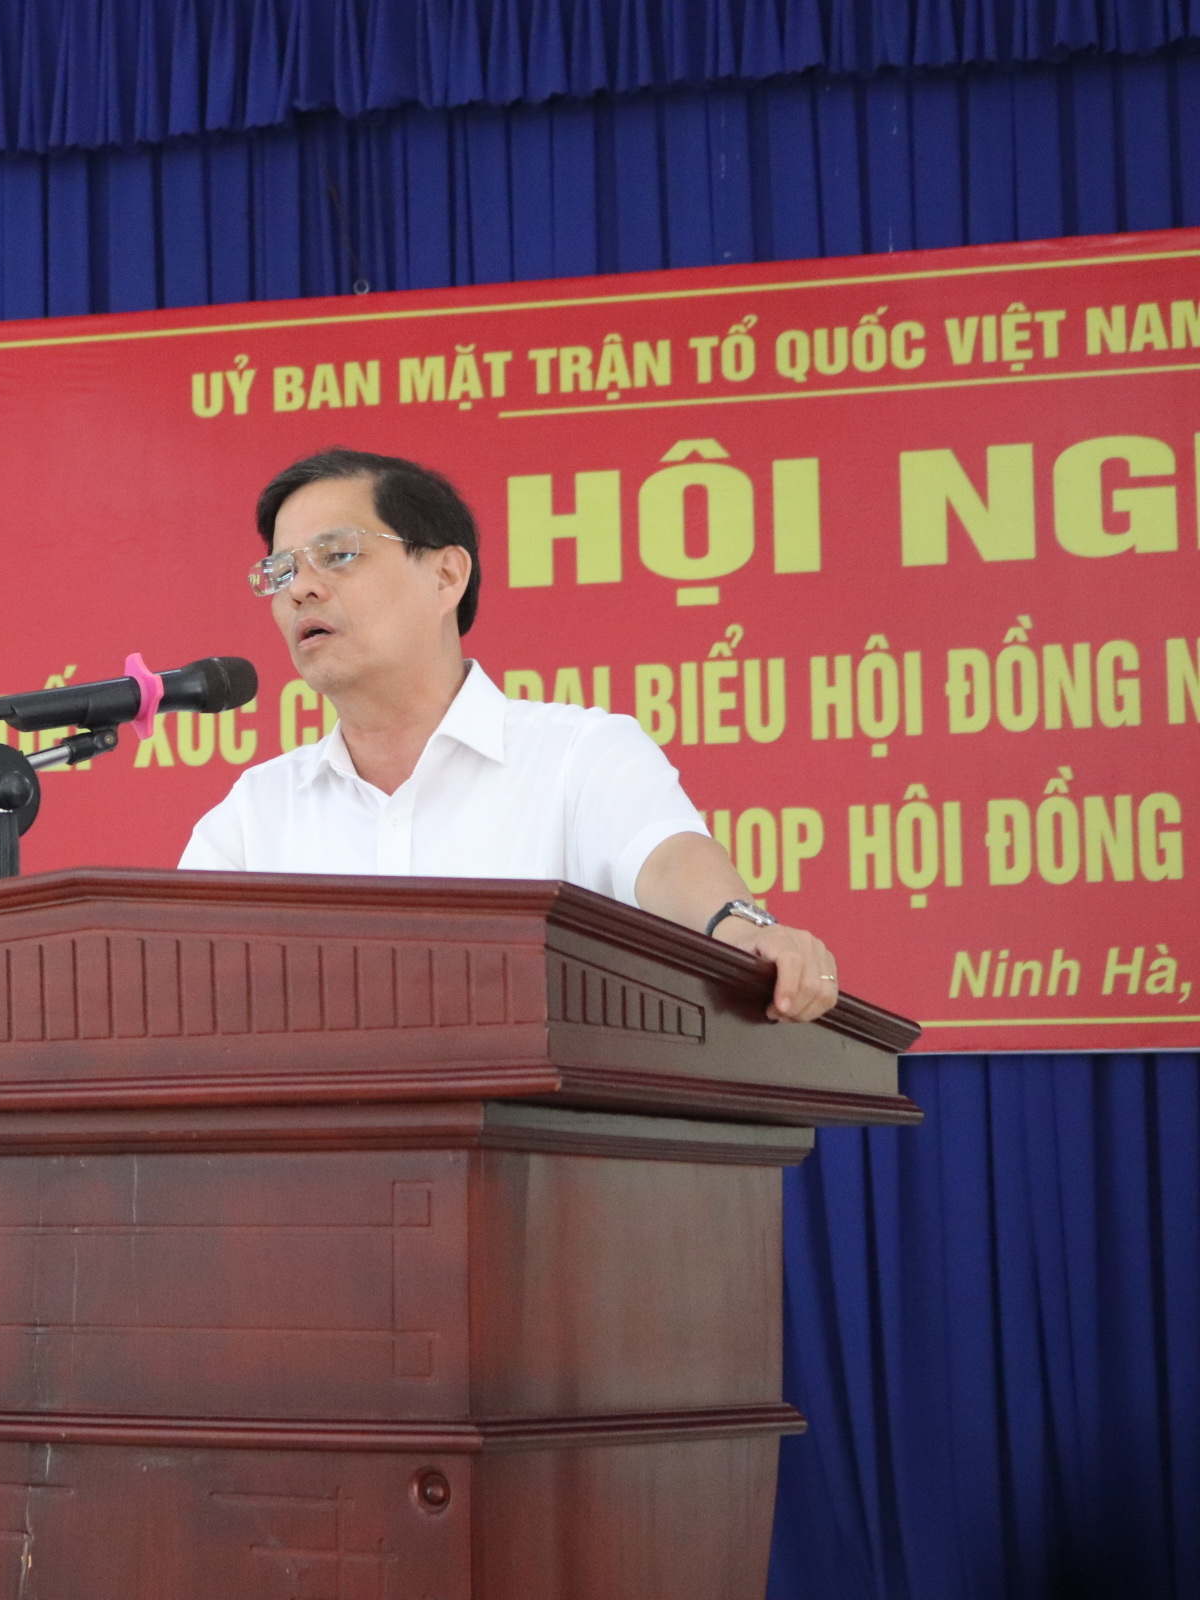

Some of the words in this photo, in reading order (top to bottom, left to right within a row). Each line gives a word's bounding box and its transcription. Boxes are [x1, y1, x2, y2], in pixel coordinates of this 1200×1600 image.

[191, 354, 257, 418] UỶ
[273, 360, 381, 412] BAN
[399, 343, 513, 411] MẶT
[528, 333, 671, 401] TRẬN
[689, 314, 758, 384] TỔ
[775, 305, 926, 382] QUỐC
[944, 302, 1066, 372] VIỆT
[507, 438, 822, 607] HỘI
[899, 432, 1200, 567] NG
[634, 623, 787, 747] BIỂU
[809, 633, 923, 758] HỘI
[944, 615, 1142, 734] ĐỒNG
[848, 783, 963, 909] HỘI
[984, 765, 1184, 886] ĐỒNG
[949, 948, 1081, 999] Ninh
[1102, 943, 1193, 1002] Hà,
